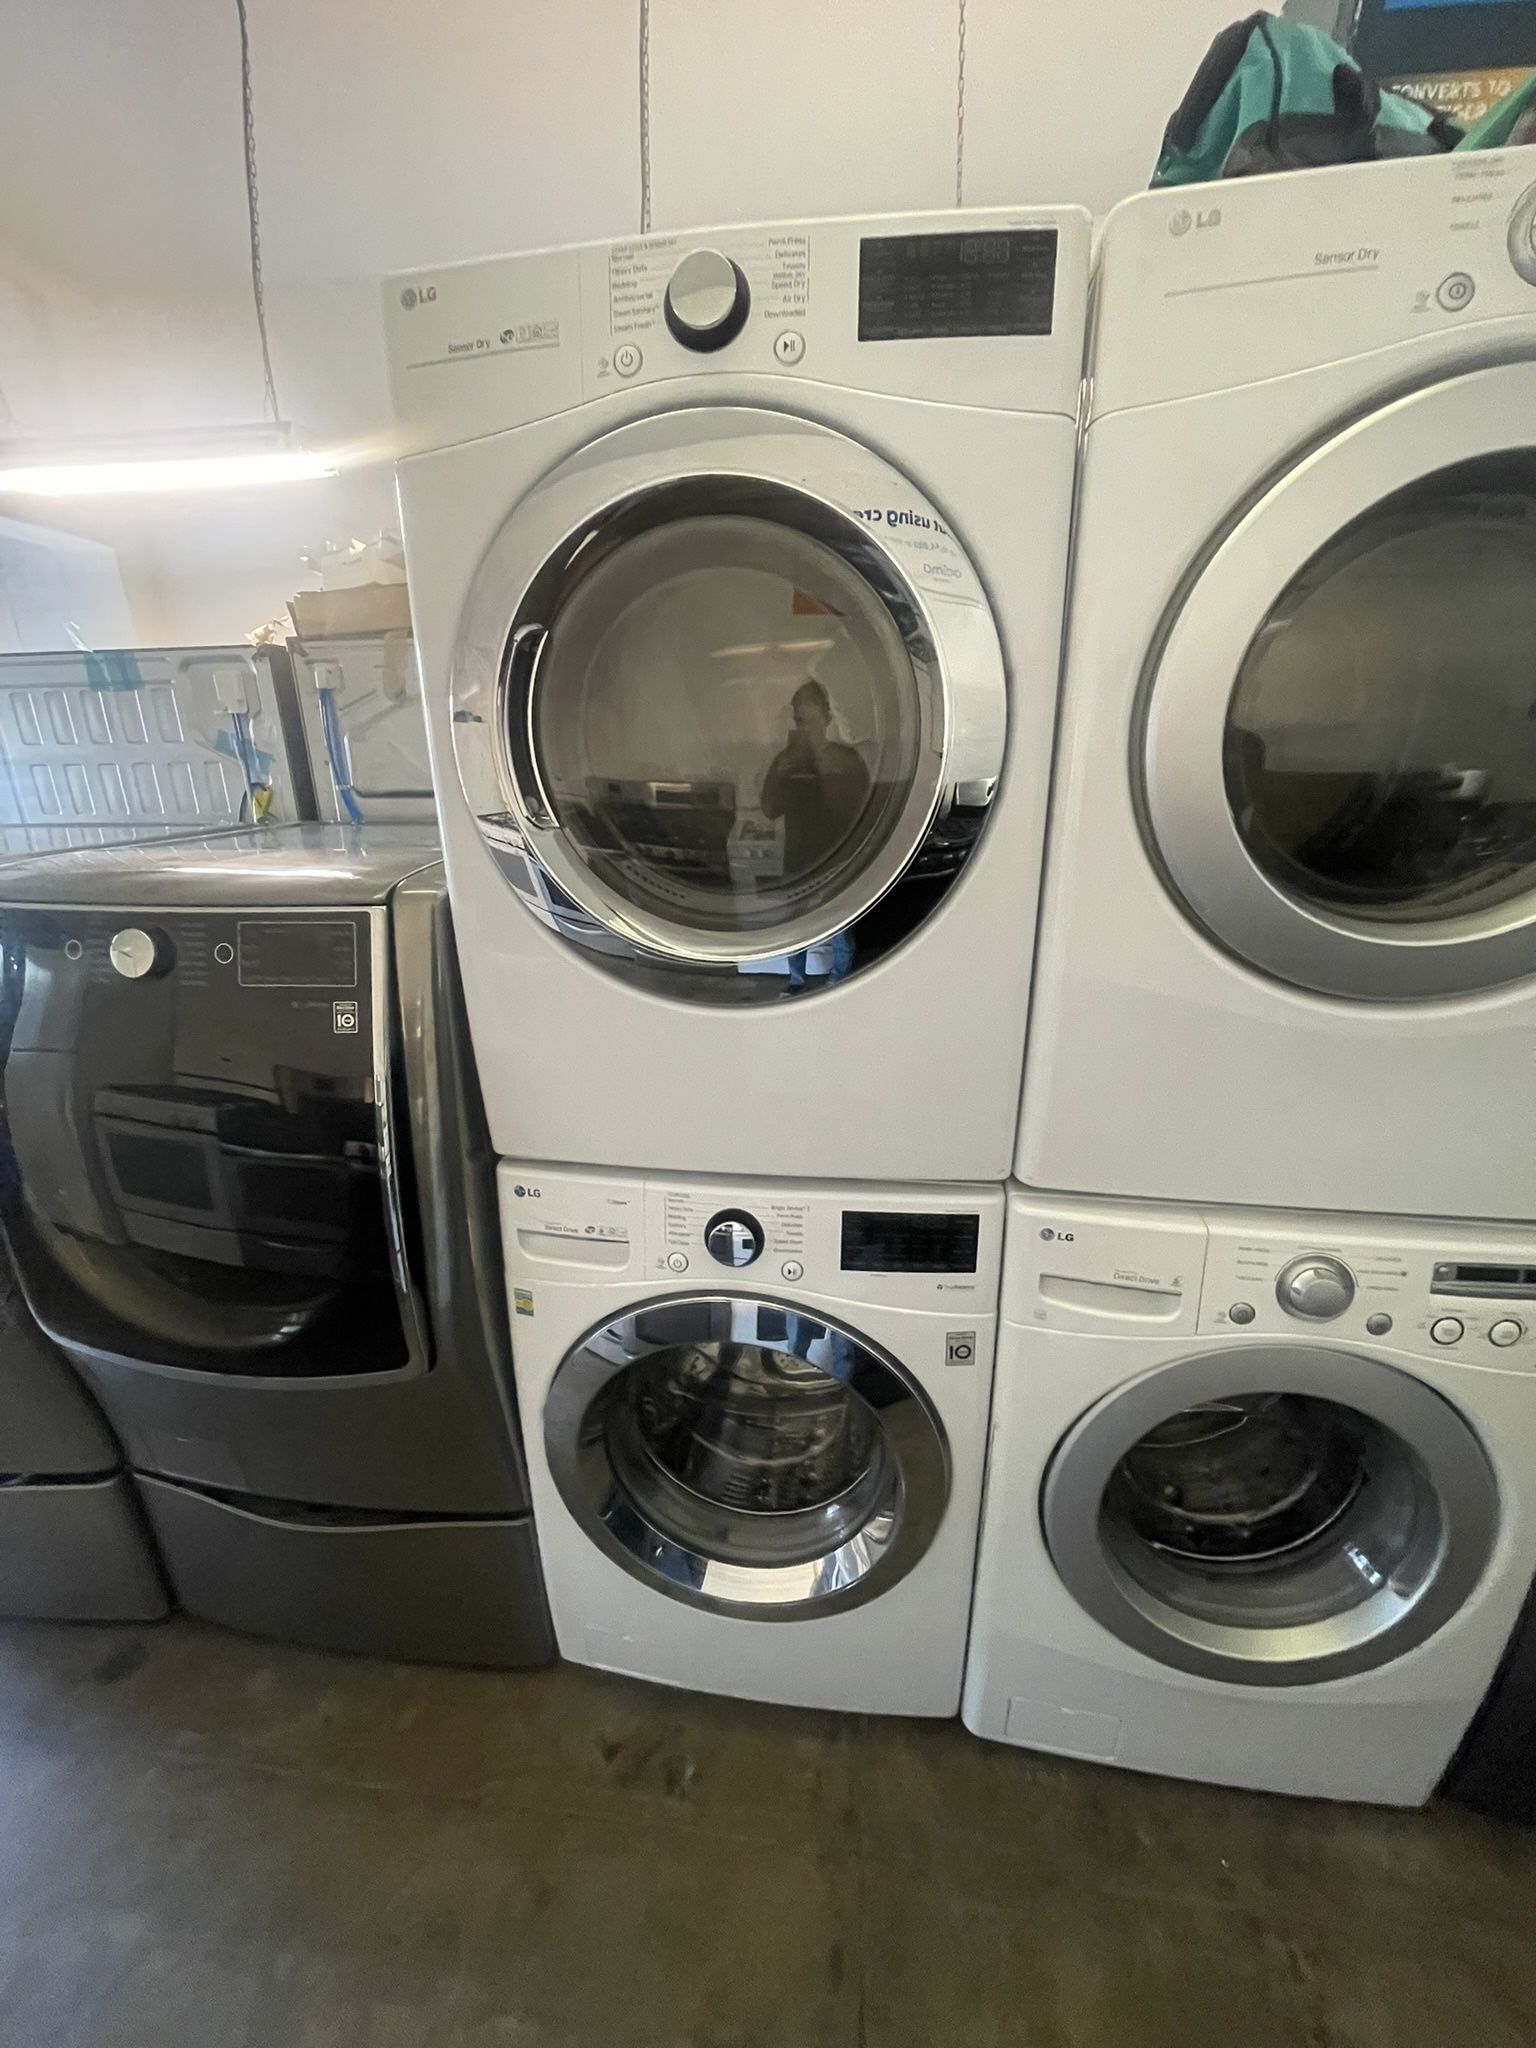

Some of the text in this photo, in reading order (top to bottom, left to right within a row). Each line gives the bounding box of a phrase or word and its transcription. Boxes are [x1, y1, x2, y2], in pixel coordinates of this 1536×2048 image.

[1195, 208, 1222, 229] LG
[1314, 248, 1380, 265] Sensor Dry
[418, 286, 437, 304] LG
[447, 337, 491, 354] Sensor Dry
[527, 1188, 541, 1198] LG
[1057, 1232, 1075, 1242] LG
[1113, 1272, 1160, 1284] Direct Drive
